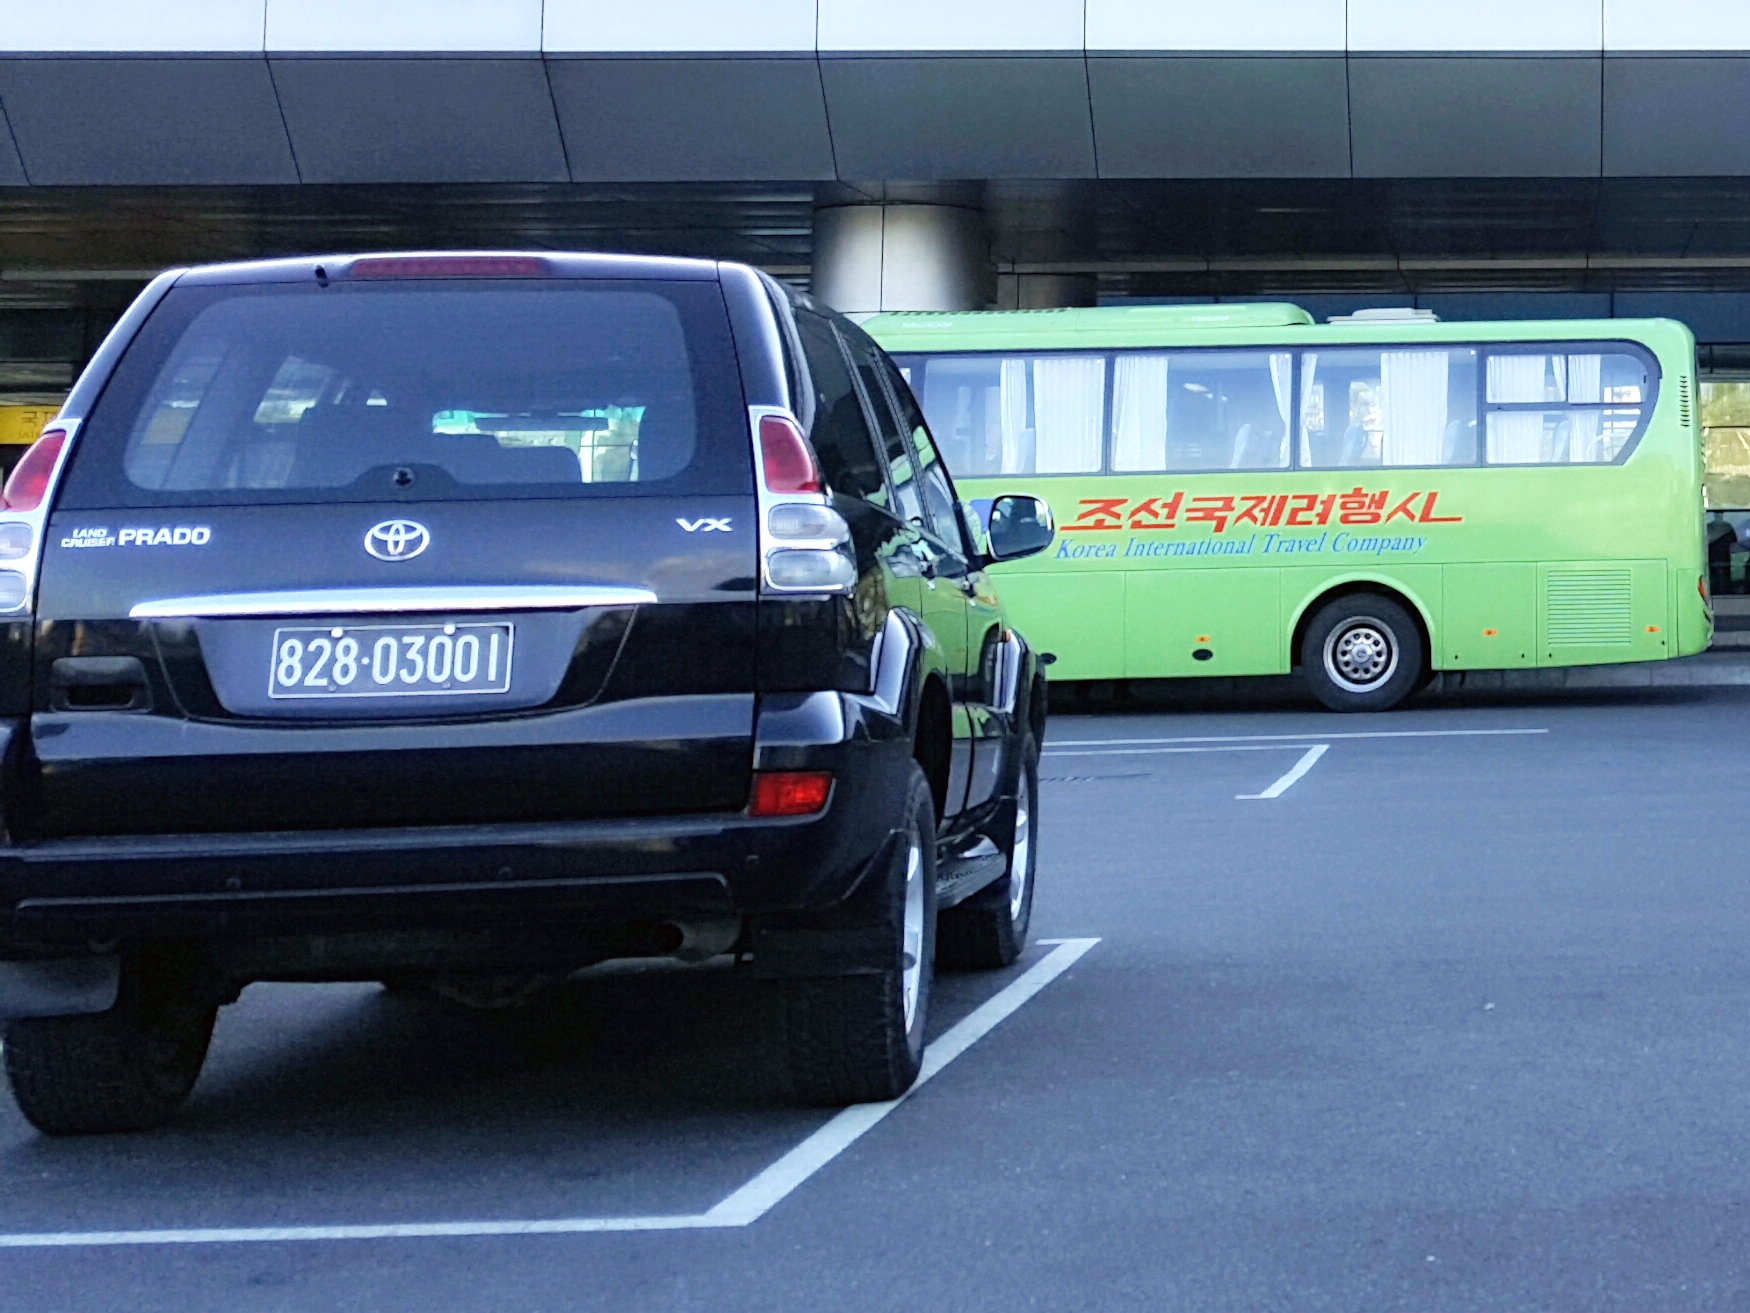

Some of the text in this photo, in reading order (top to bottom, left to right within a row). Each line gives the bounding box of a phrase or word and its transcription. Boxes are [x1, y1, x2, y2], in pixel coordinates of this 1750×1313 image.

[73, 528, 108, 538] LAND
[676, 517, 734, 532] VX
[118, 527, 211, 546] PRADO
[1054, 532, 1427, 559] Korea International Travel Company
